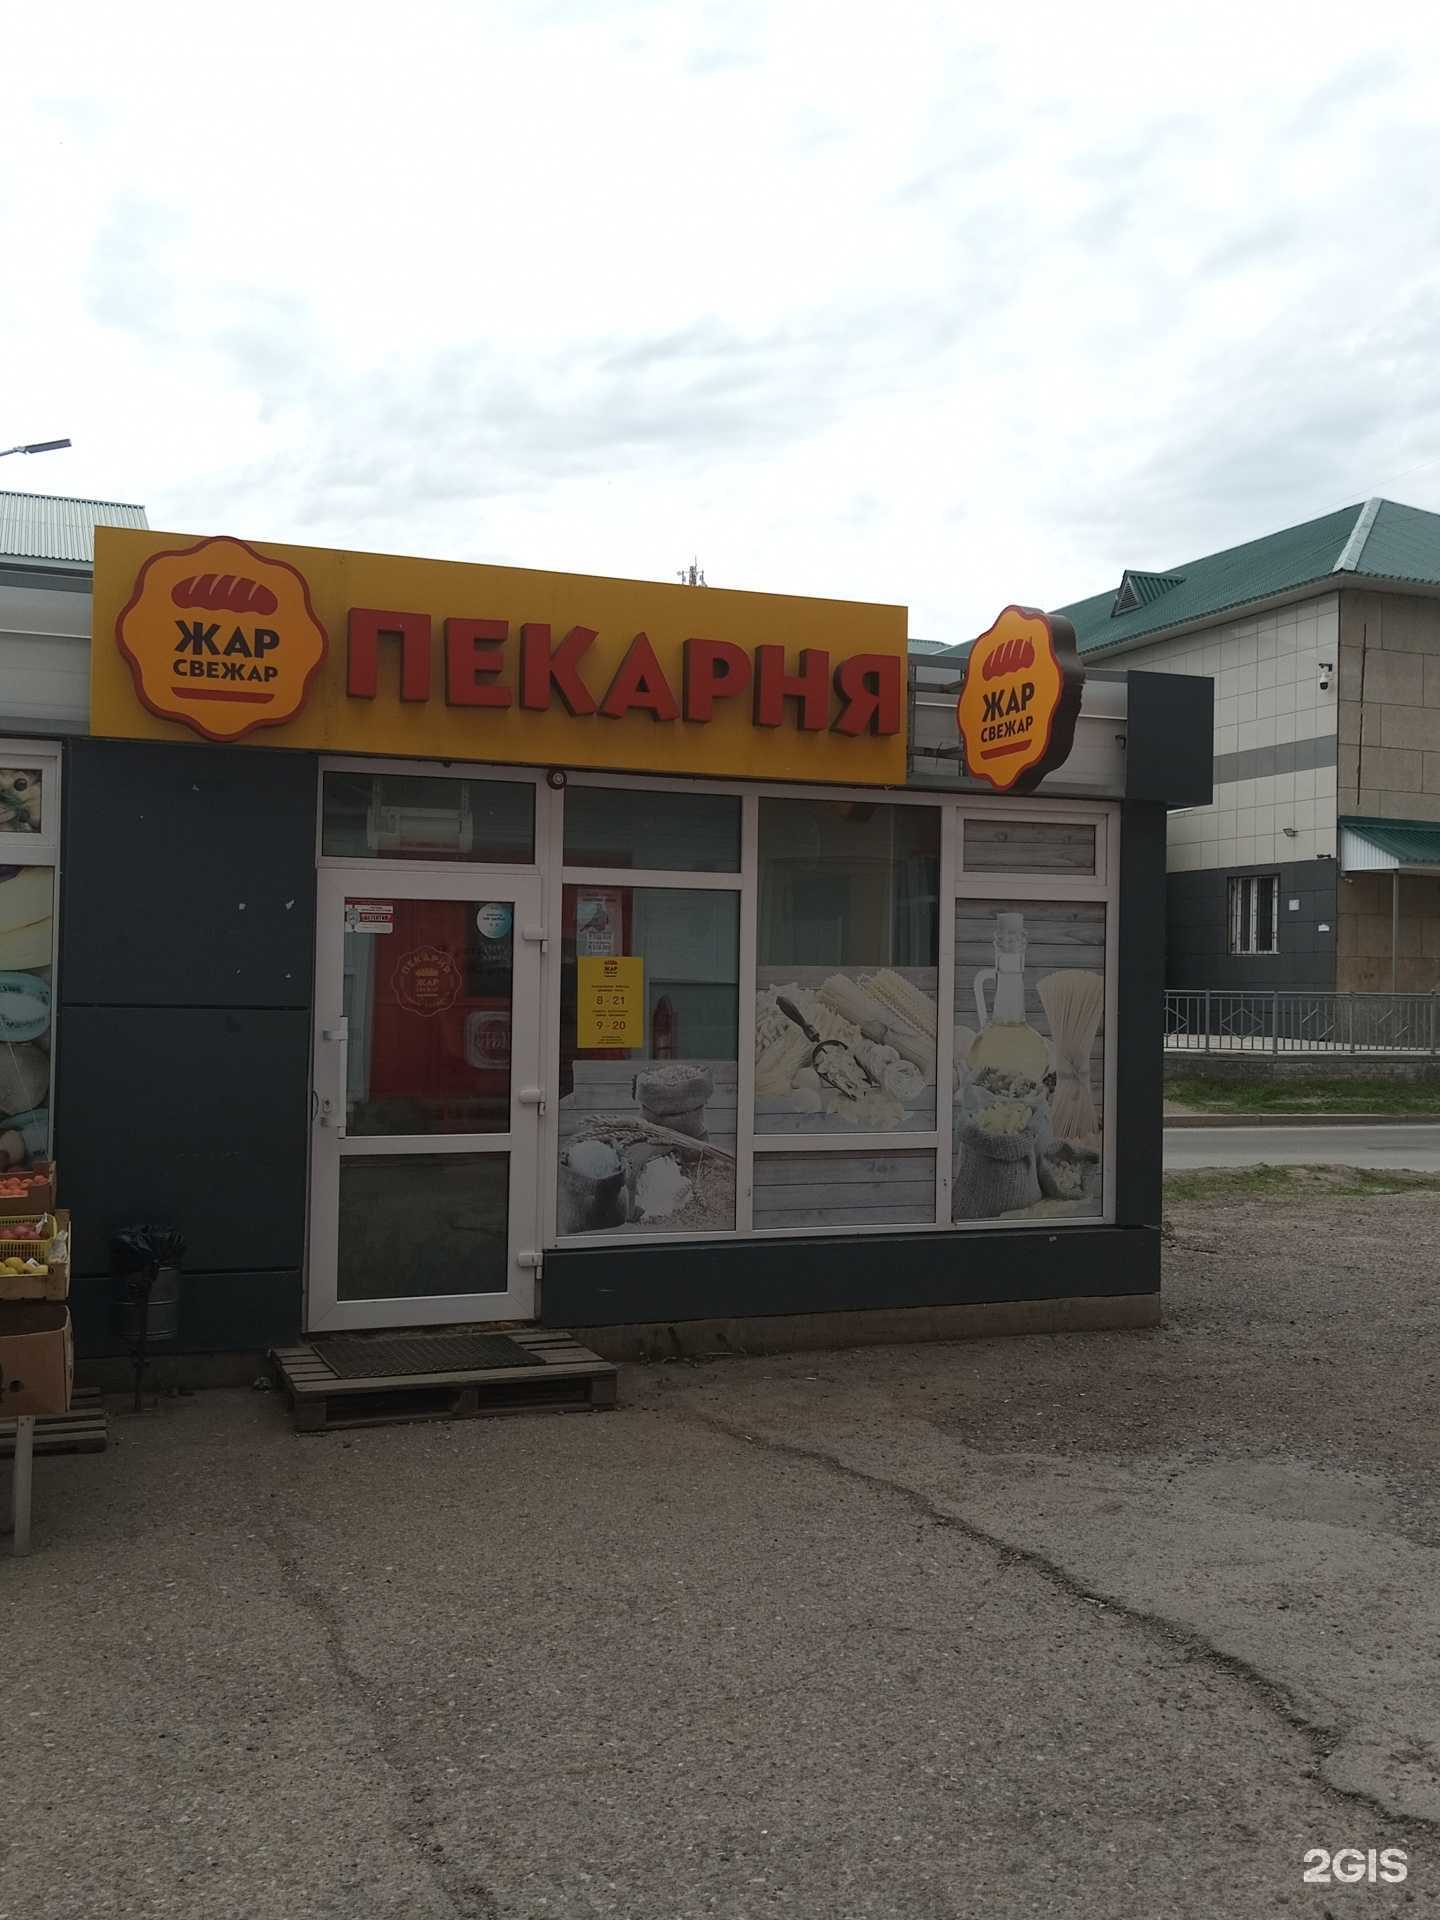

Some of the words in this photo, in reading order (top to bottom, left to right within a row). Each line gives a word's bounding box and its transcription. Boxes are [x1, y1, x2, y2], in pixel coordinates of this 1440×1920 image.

[174, 620, 280, 659] ЖАР
[172, 658, 279, 684] СВЕЖАР
[346, 607, 900, 738] ПЕКАРНЯ
[982, 682, 1034, 722] ЖАР
[980, 716, 1033, 743] СВЕЖАР
[596, 996, 604, 1005] 8
[612, 996, 625, 1005] 21
[596, 1021, 604, 1030] 9
[612, 1021, 626, 1030] 20
